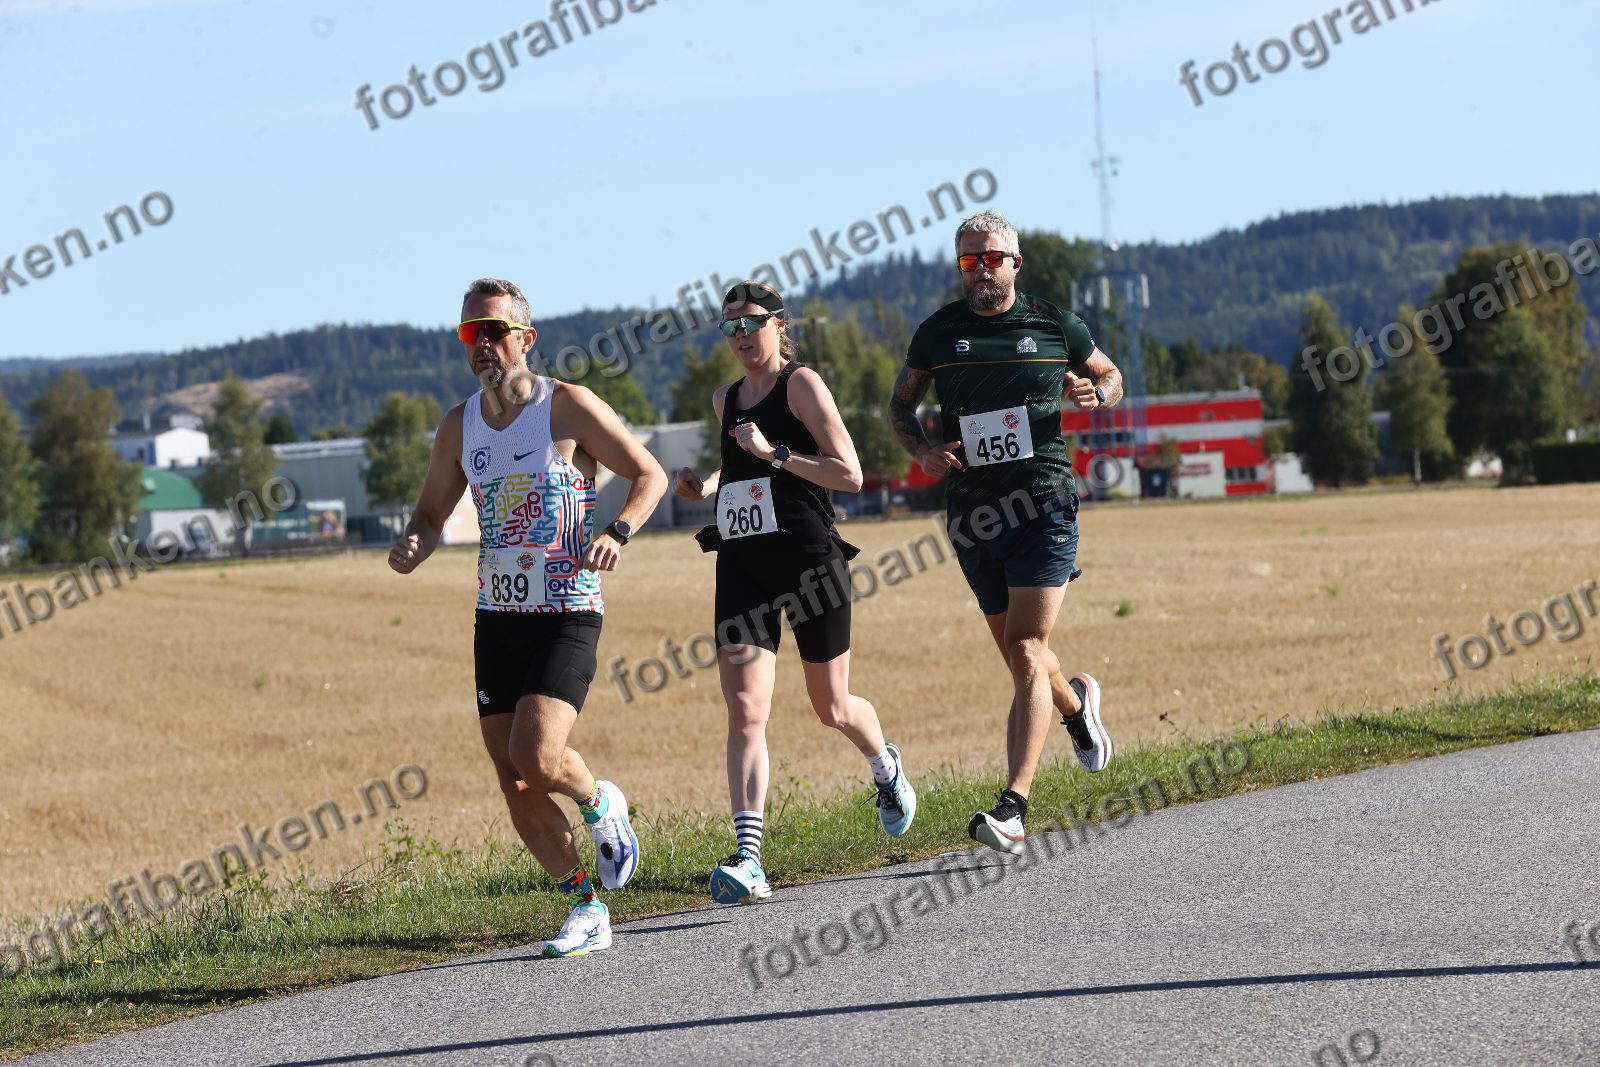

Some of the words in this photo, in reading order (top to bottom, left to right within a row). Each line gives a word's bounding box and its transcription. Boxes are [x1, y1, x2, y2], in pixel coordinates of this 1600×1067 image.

[977, 432, 1020, 462] 456
[726, 504, 763, 536] 260
[491, 573, 529, 603] 839
